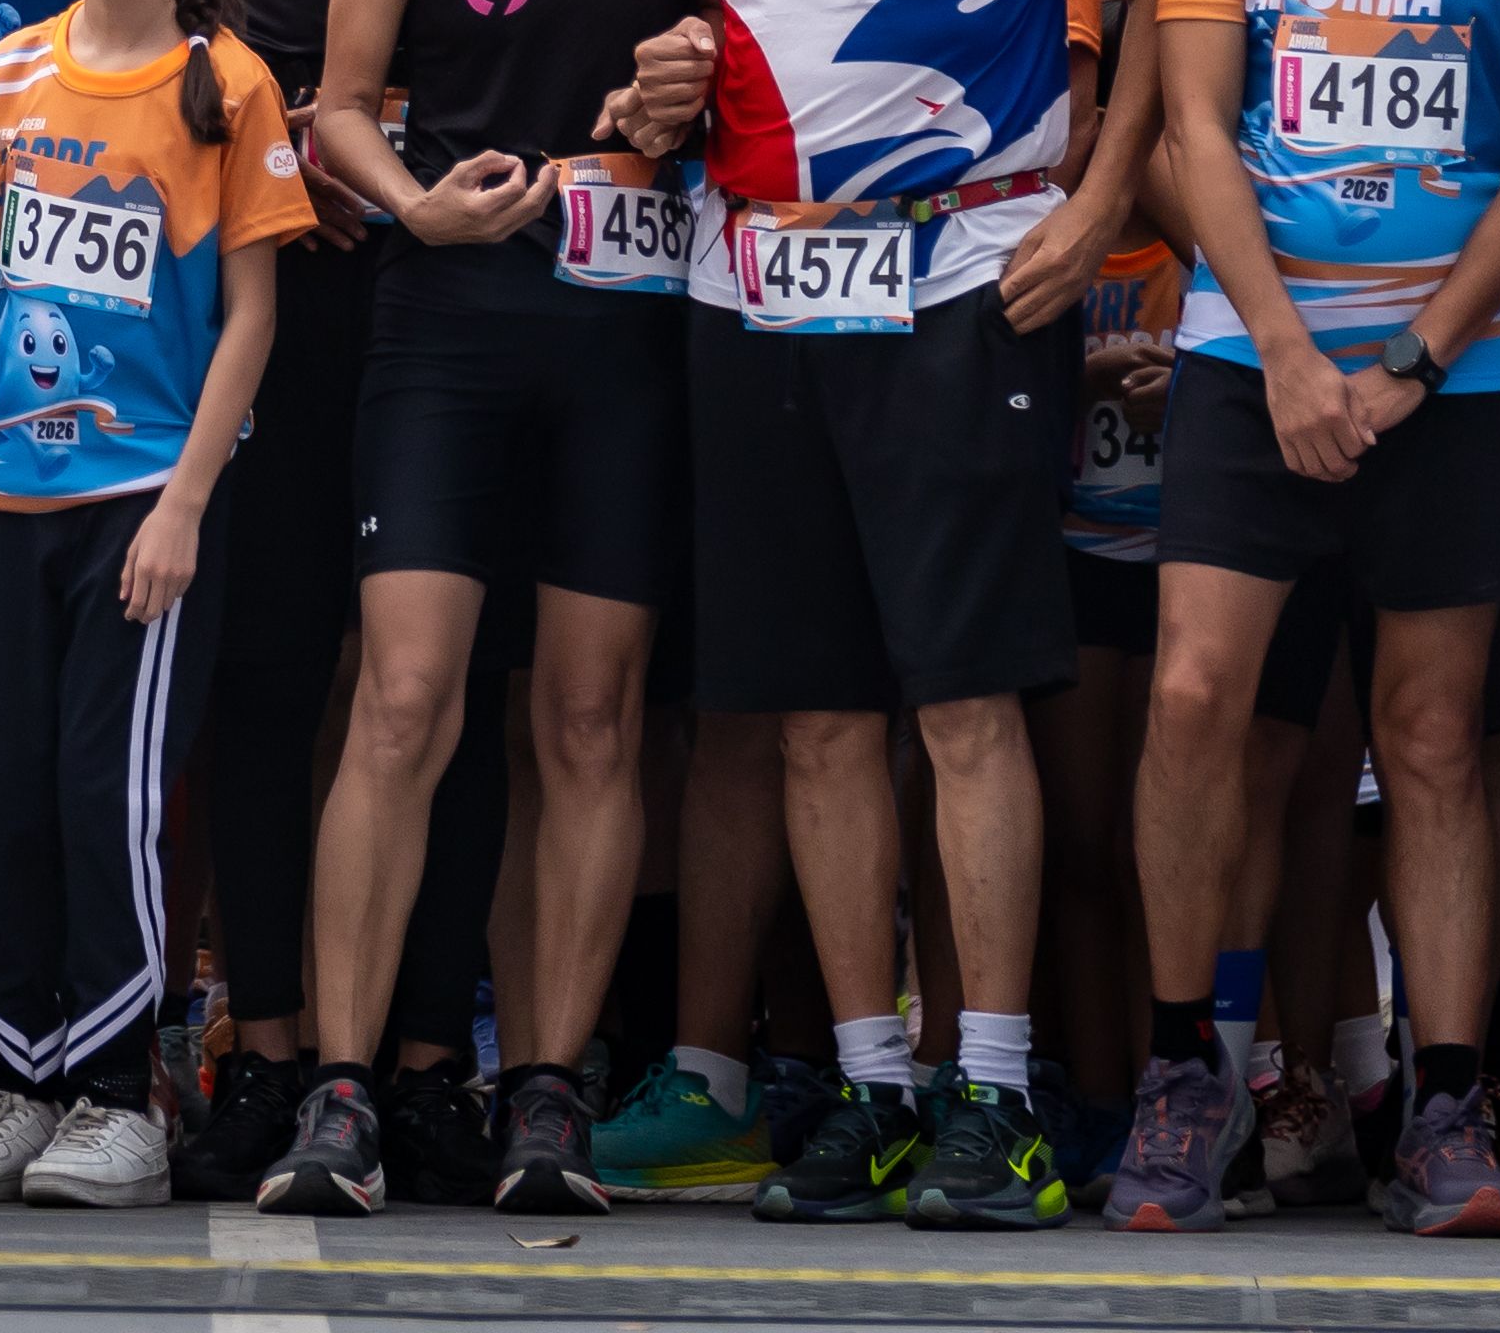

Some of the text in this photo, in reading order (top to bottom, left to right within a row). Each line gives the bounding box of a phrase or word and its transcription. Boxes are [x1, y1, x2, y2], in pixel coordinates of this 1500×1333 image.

[1288, 33, 1328, 52] AHORRA
[1285, 60, 1296, 118] IDEMSPORT
[1309, 61, 1460, 132] 4184
[1281, 118, 1300, 133] 5K
[1341, 177, 1389, 202] 2026
[18, 197, 151, 282] 3756
[764, 235, 904, 300] 4574
[36, 420, 76, 441] 2026
